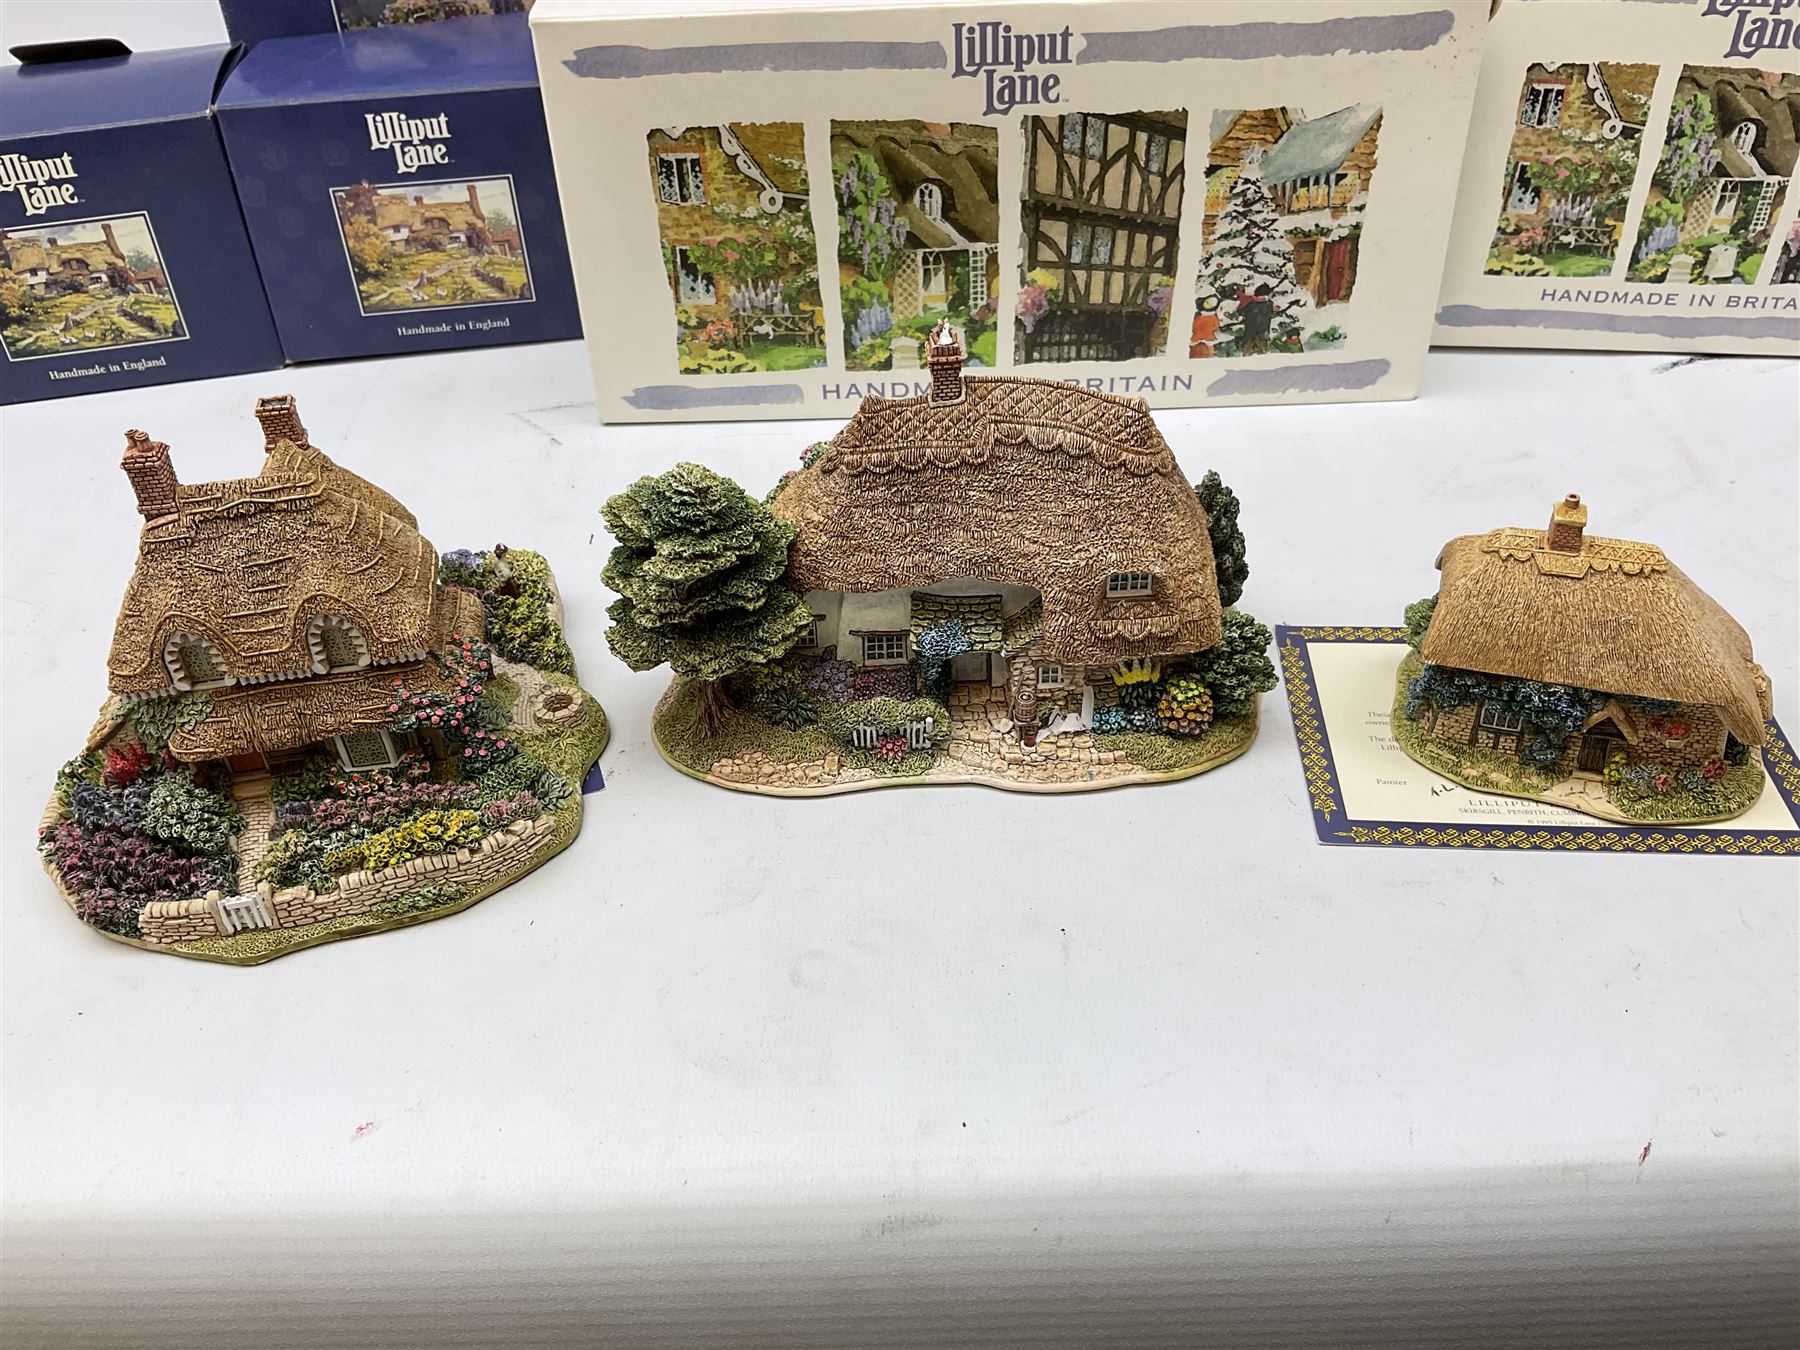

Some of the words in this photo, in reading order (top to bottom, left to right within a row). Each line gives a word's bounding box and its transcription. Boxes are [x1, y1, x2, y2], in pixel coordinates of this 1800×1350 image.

[952, 21, 1074, 79] Lilliput
[982, 68, 1061, 117] Lane
[364, 111, 452, 151] Lilliput
[0, 151, 78, 192] illiput
[392, 143, 449, 174] Lane
[16, 183, 79, 217] Lane
[1540, 288, 1680, 306] HANDMADE
[1688, 294, 1716, 307] IN
[1725, 295, 1798, 310] BRITA
[397, 322, 453, 337] Handmade
[454, 322, 466, 332] in
[468, 317, 511, 332] England
[48, 363, 107, 381] Handmade
[108, 363, 121, 373] in
[122, 355, 167, 372] England
[822, 381, 932, 400] HANDM
[1376, 778, 1408, 786] Painter
